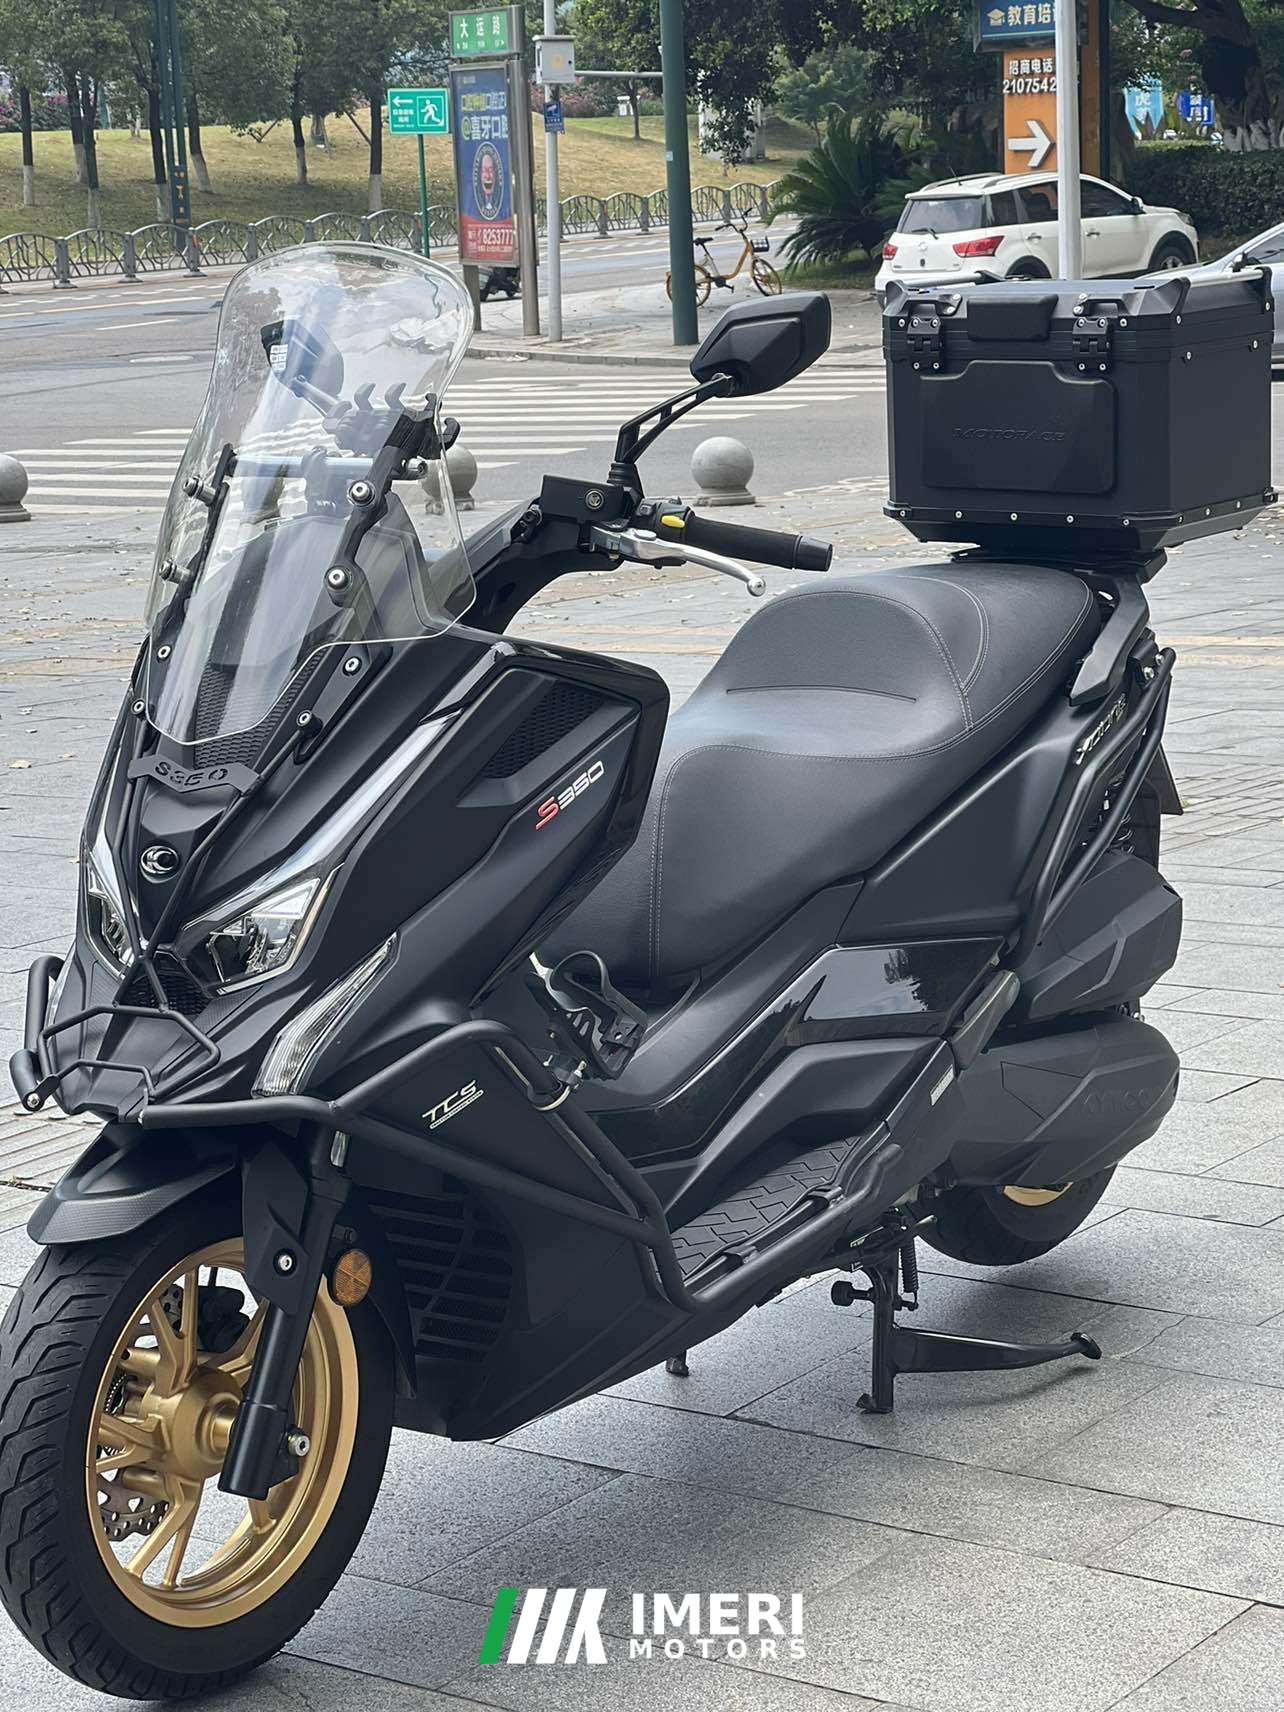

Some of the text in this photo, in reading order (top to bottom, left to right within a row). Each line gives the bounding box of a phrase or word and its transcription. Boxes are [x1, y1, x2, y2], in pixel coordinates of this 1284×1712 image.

[1007, 3, 1056, 26] 教育培
[460, 15, 500, 38] 大运路
[1009, 58, 1053, 75] 招商电话
[535, 760, 604, 830] S350
[422, 1080, 477, 1122] TCS
